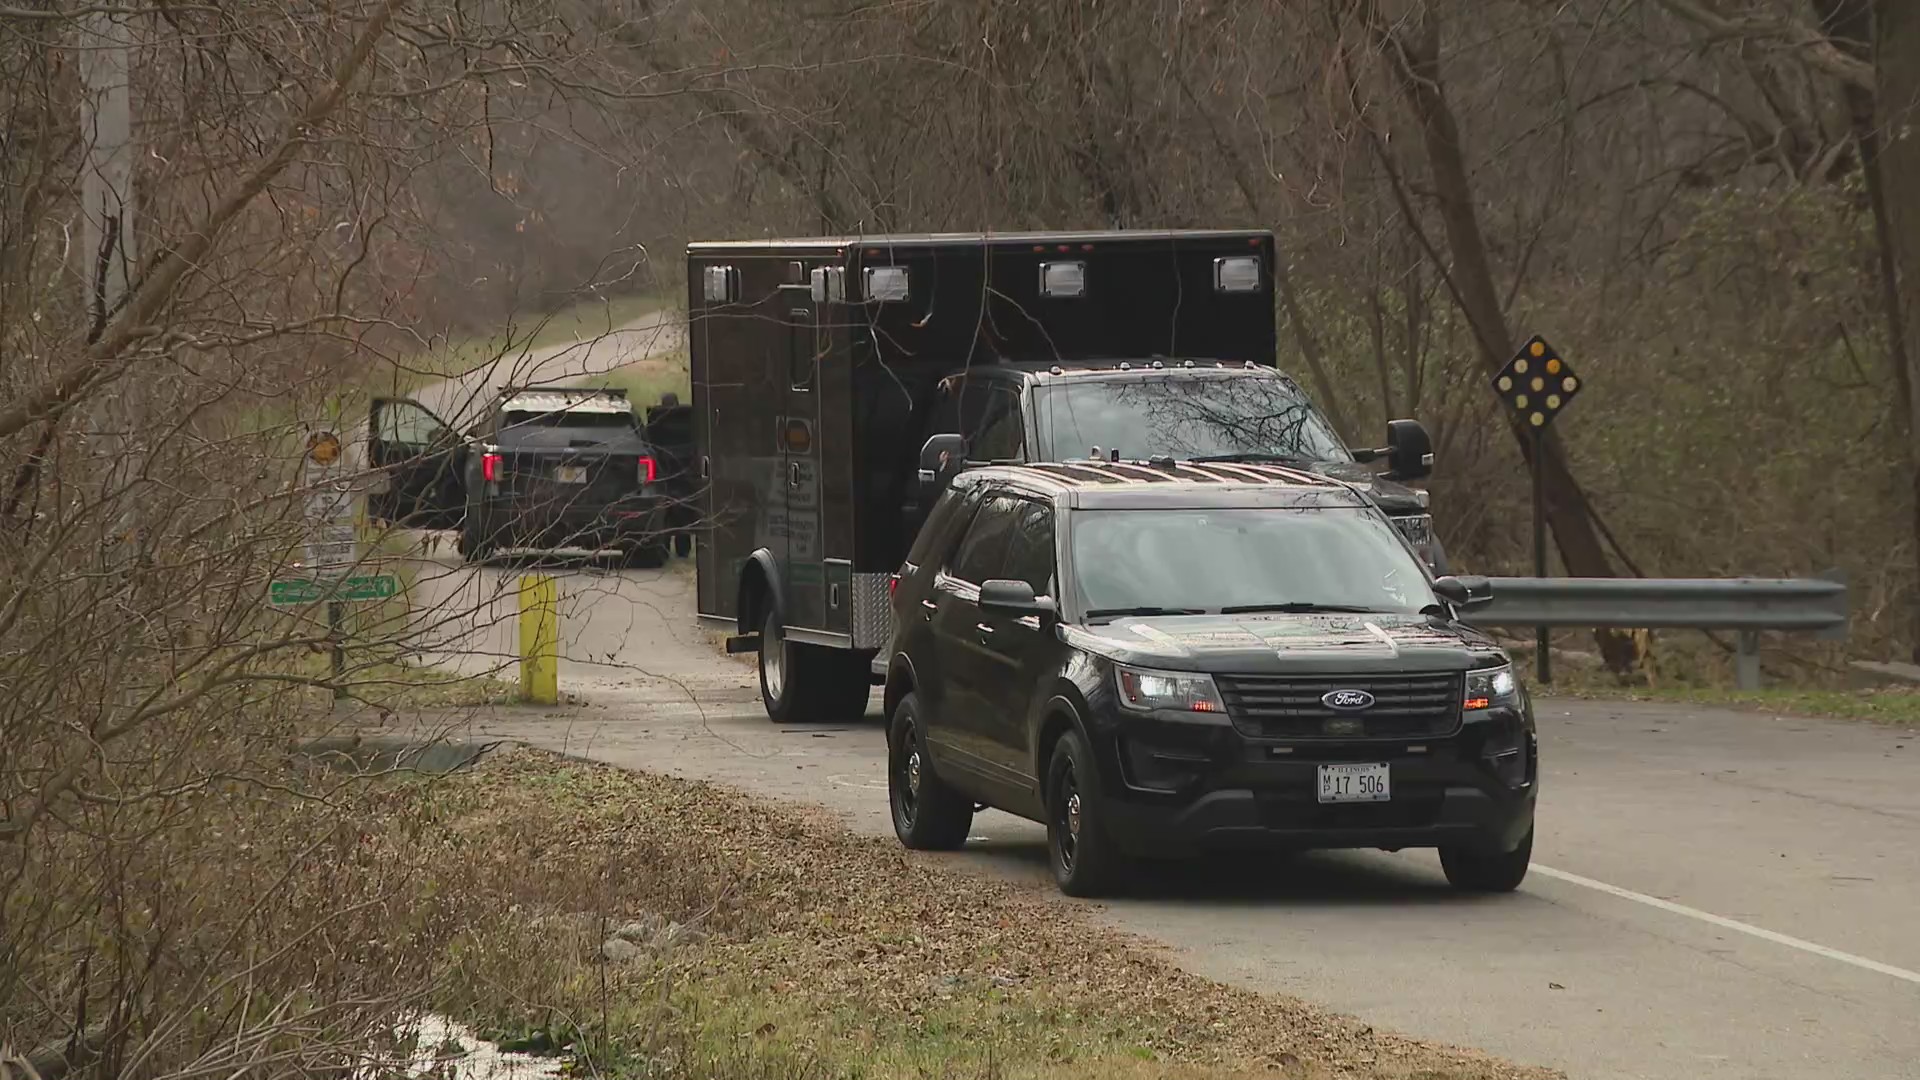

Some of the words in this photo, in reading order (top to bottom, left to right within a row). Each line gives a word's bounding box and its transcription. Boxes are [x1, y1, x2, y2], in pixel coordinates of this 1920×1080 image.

[1335, 693, 1363, 704] Ford
[1335, 776, 1350, 794] 17
[1359, 775, 1384, 793] 506
